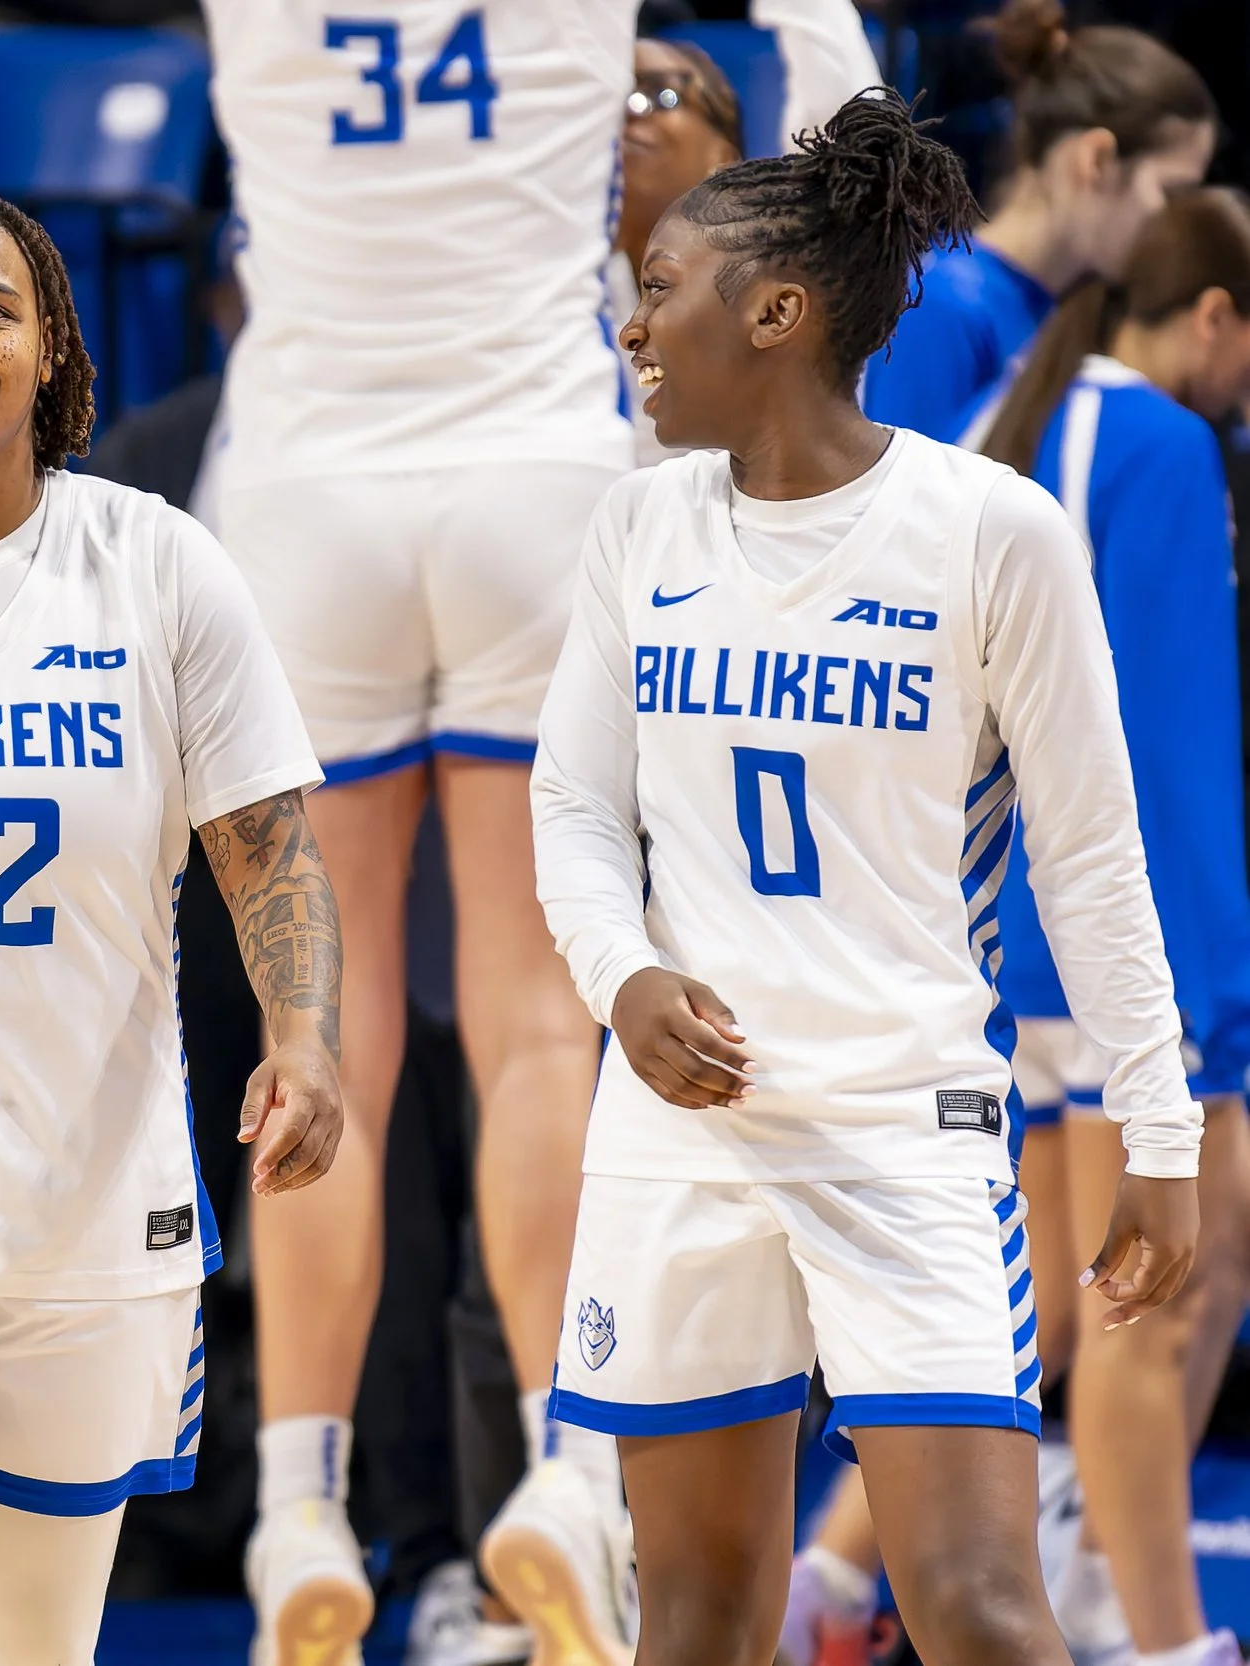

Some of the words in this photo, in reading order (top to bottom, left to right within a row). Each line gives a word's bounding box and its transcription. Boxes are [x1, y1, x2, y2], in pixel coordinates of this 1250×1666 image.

[324, 8, 500, 145] 34
[831, 598, 939, 631] A10
[31, 644, 127, 671] A10
[635, 644, 934, 732] BILLIKENS
[730, 746, 822, 898] 0
[987, 1104, 998, 1122] M
